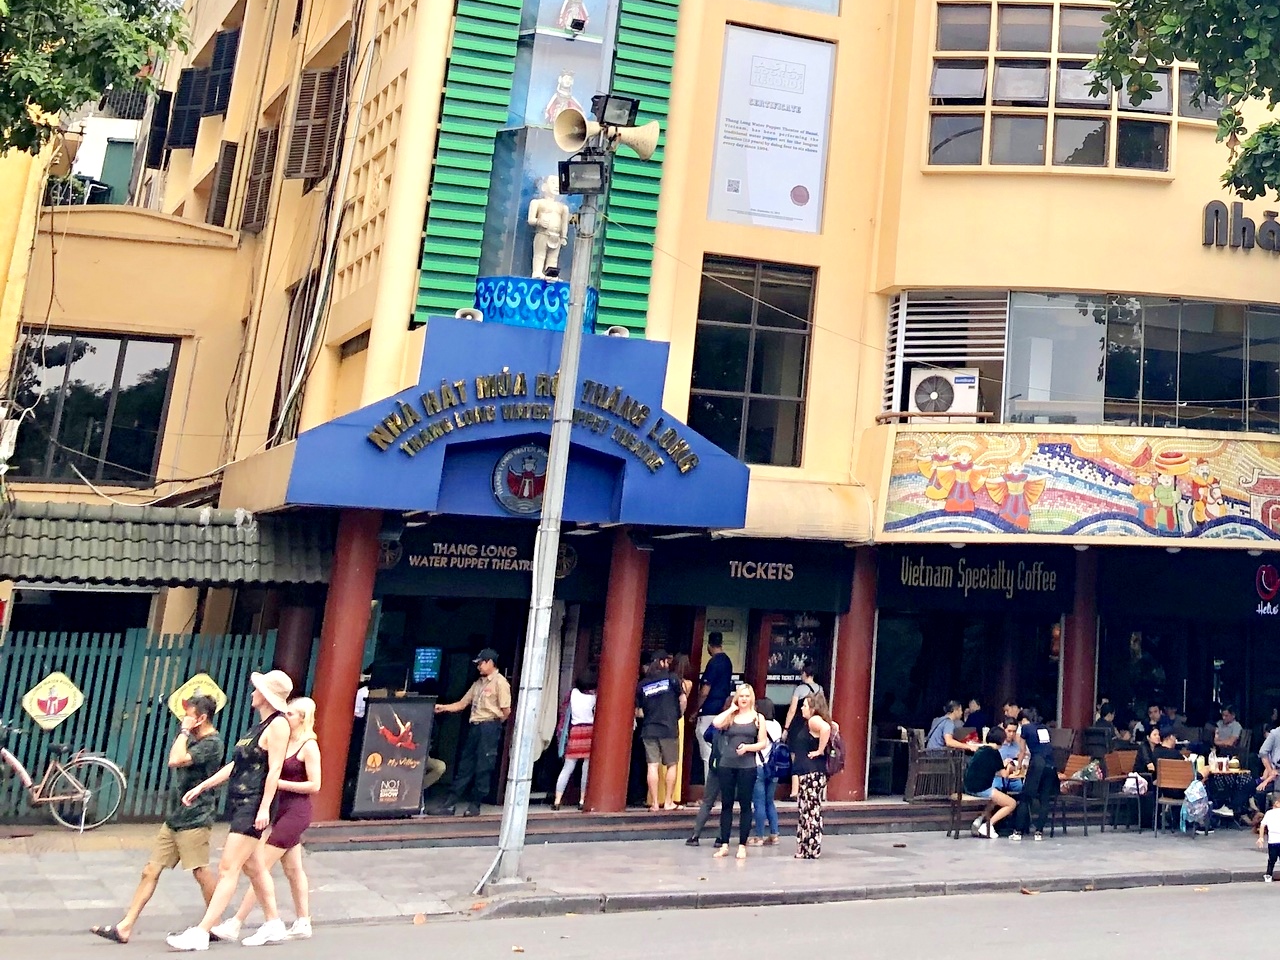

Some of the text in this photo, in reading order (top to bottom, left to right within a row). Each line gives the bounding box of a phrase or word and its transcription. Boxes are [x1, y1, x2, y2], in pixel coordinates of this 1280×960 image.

[367, 399, 422, 451] NHÀ
[420, 377, 468, 416] HÁT
[476, 366, 527, 399] MÚA
[400, 417, 454, 457] THANG
[453, 404, 496, 428] LONG
[500, 402, 552, 420] WATER
[409, 555, 447, 568] WATER
[450, 557, 489, 569] PUPPET
[432, 543, 518, 557] THANG LONG
[729, 560, 794, 581] TICKETS
[900, 556, 1057, 599] Vietnam Specialty Coffee
